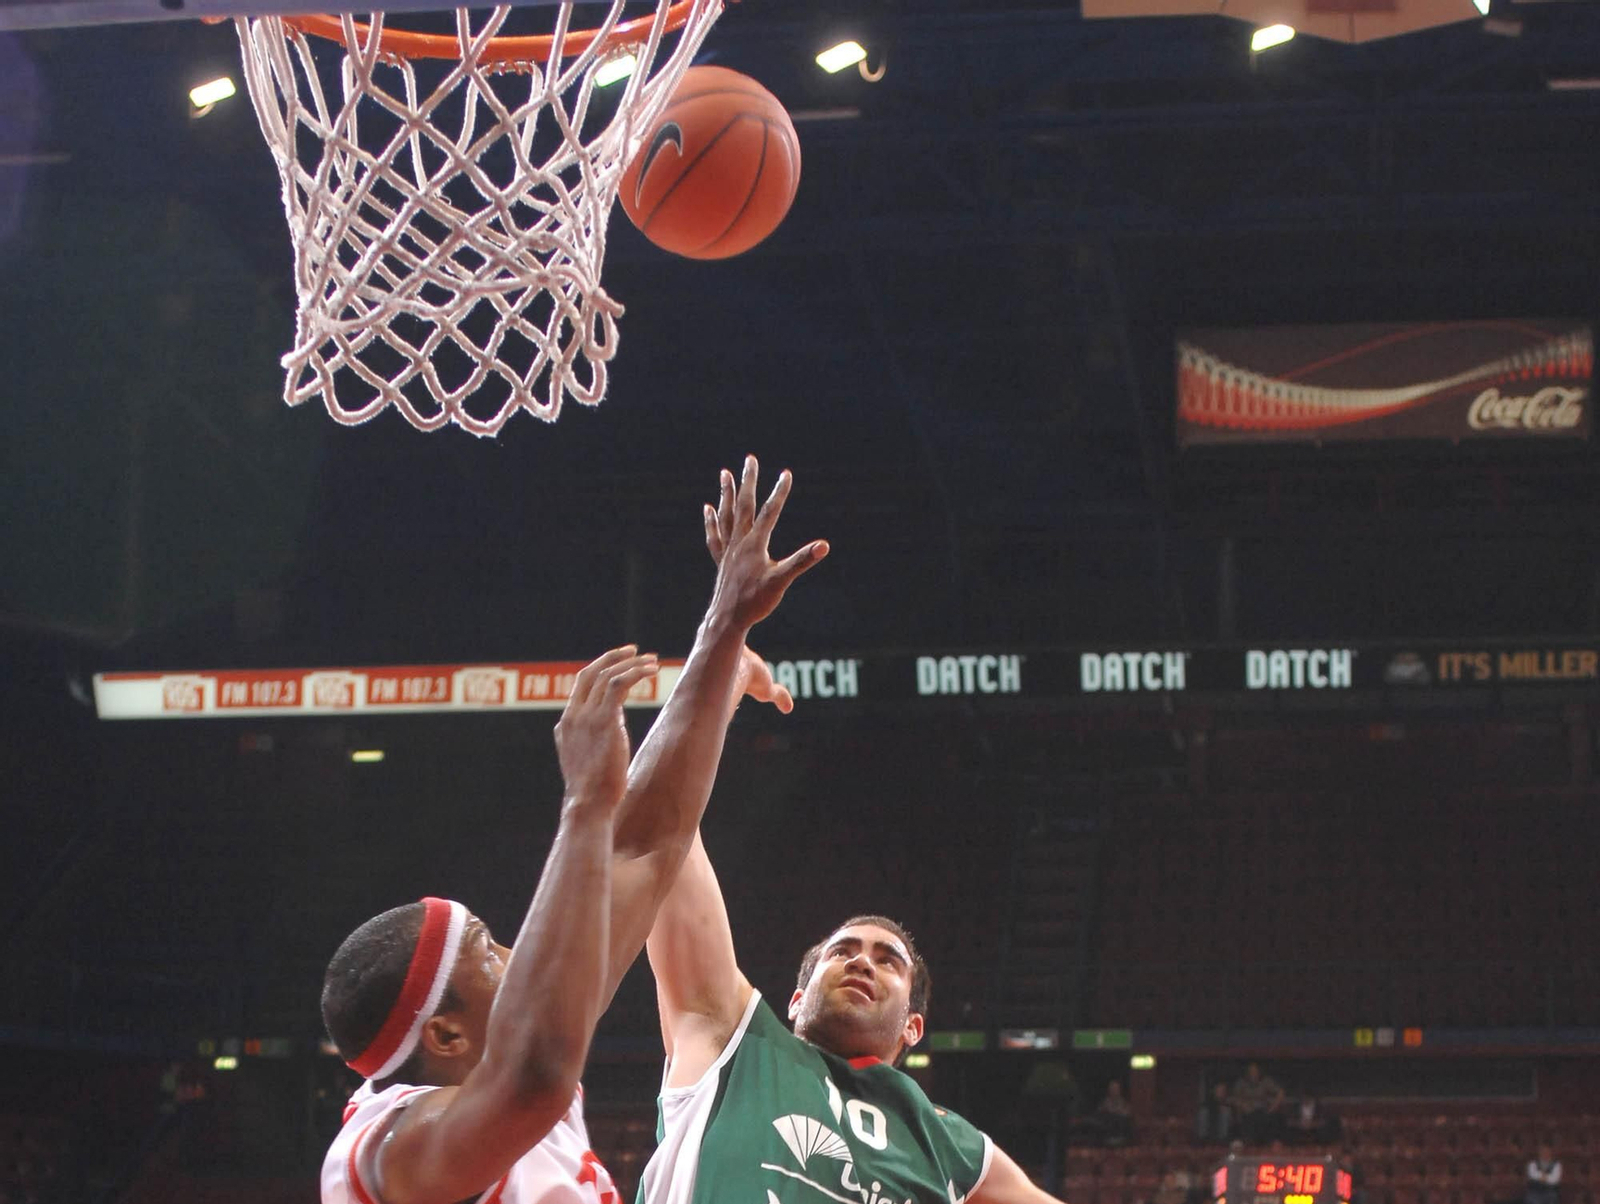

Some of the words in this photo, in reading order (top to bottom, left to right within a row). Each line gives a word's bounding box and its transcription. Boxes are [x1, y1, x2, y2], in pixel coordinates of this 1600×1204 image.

[766, 659, 859, 699] ATCH
[916, 655, 1022, 695] DATCH
[1080, 651, 1187, 691] DATCH
[1246, 649, 1352, 689] DATCH
[1438, 652, 1492, 681] IT'S
[1499, 650, 1600, 679] MILLER
[370, 677, 398, 702] FM
[1256, 1164, 1324, 1193] 5:40
